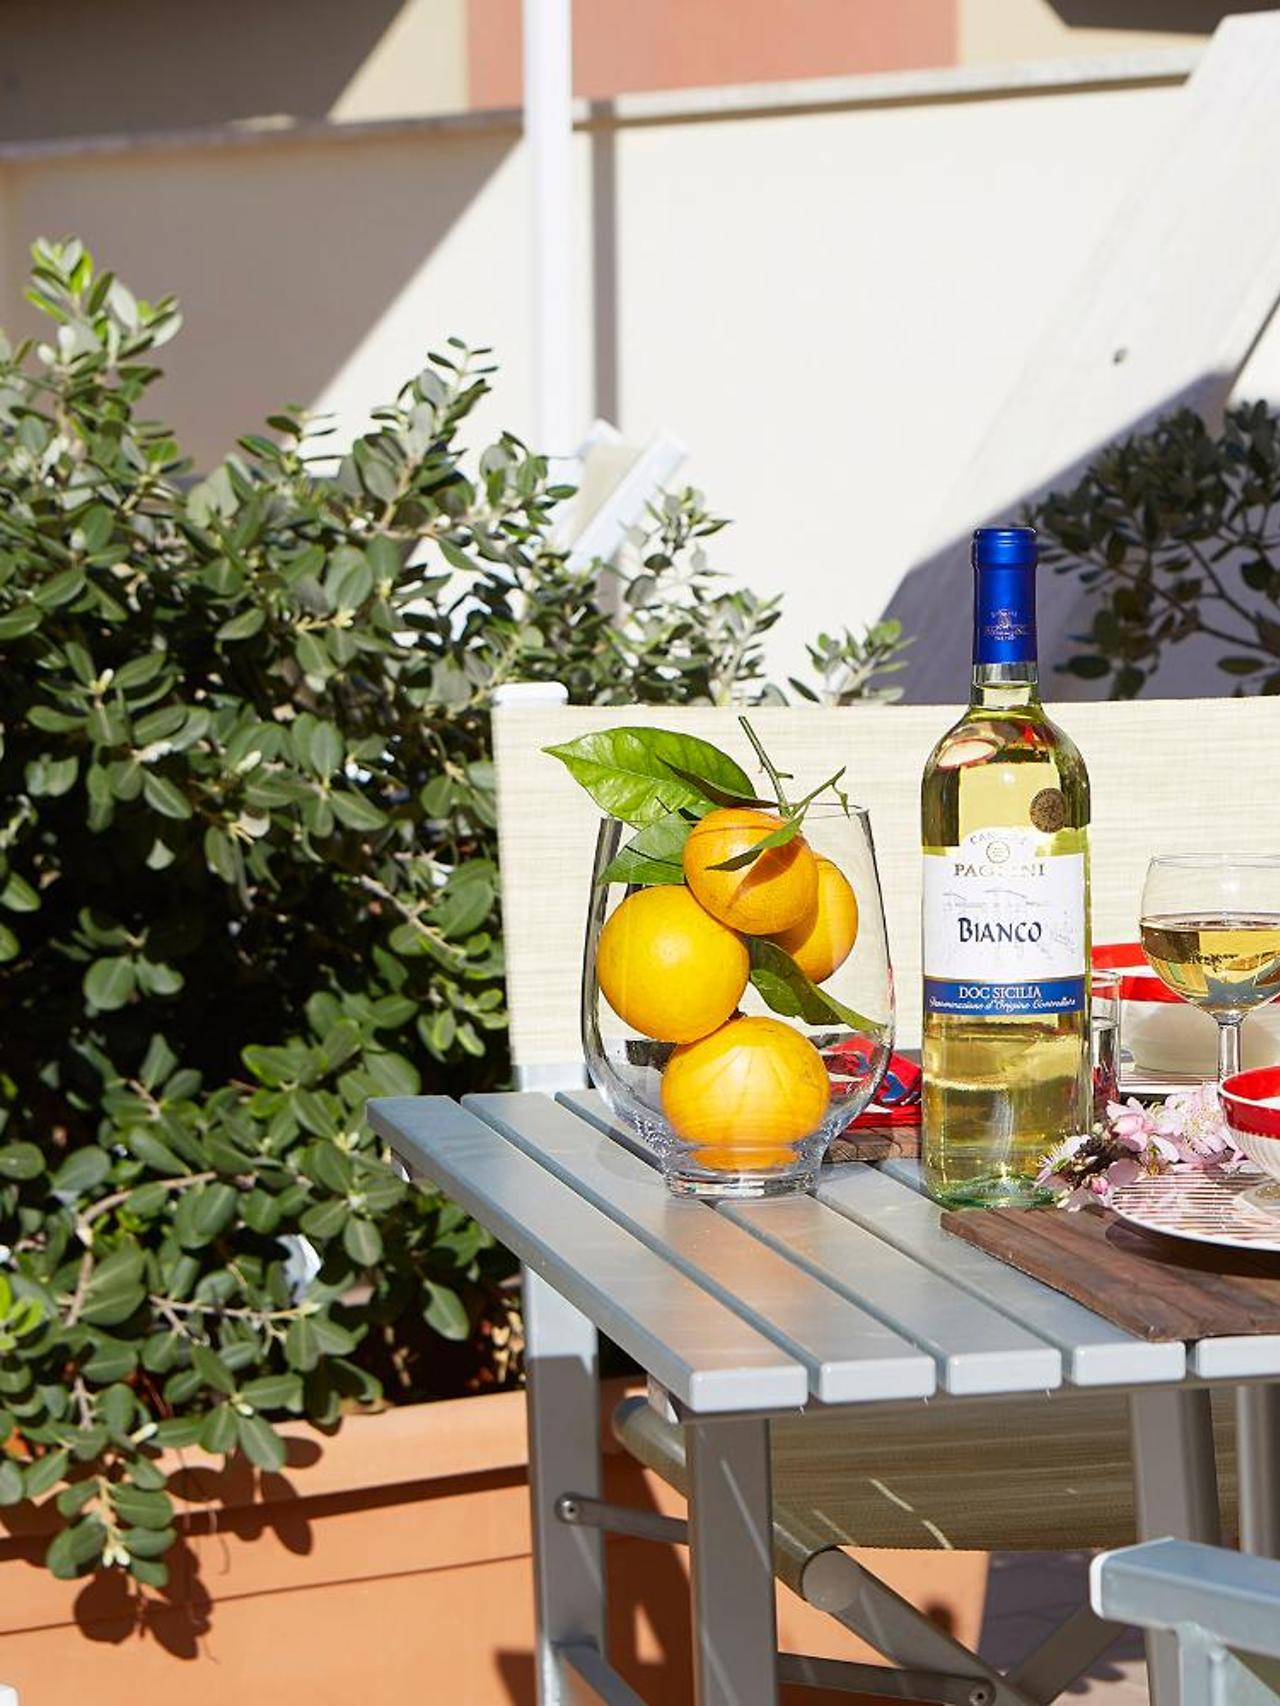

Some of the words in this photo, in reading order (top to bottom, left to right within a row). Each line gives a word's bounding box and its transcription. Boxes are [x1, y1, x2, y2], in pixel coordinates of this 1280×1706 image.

[958, 917, 1042, 943] BIANCO
[959, 986, 991, 999] DOC
[992, 986, 1042, 999] SICILIA
